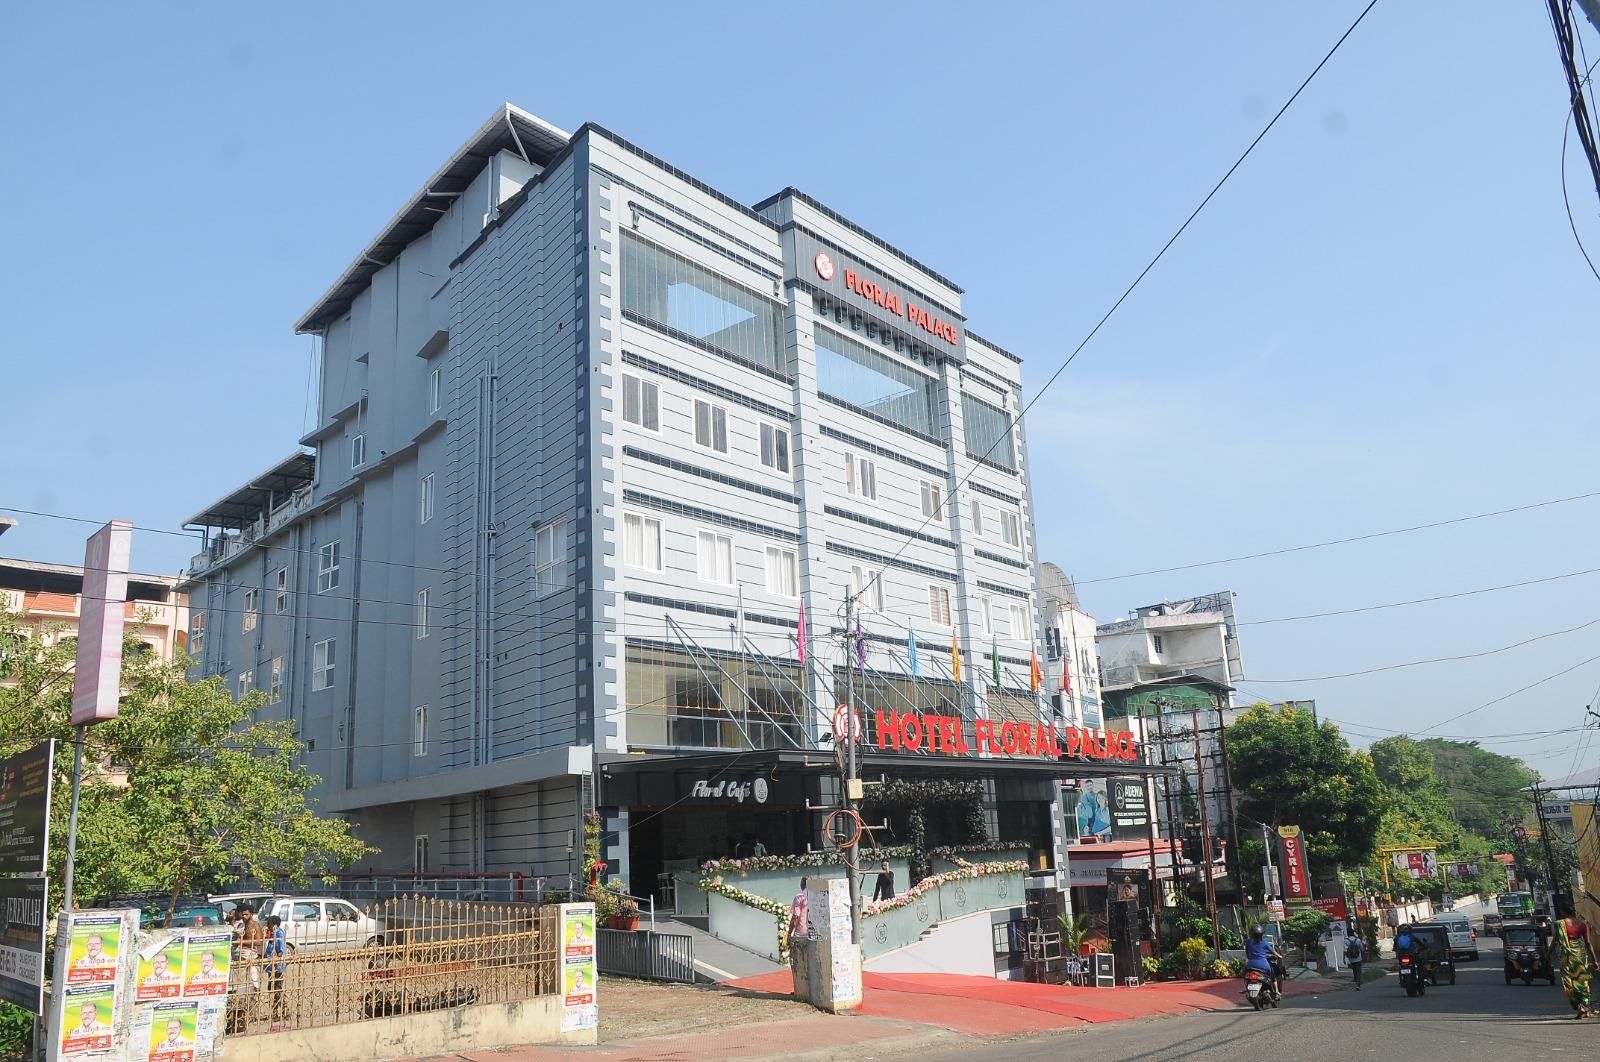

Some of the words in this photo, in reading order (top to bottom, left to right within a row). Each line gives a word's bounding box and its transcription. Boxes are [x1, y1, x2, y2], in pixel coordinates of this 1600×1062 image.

[845, 269, 904, 316] FLORAL
[907, 303, 959, 345] PALACE
[875, 707, 968, 753] HOTEL
[974, 718, 1062, 757] FLORAL
[1067, 727, 1137, 761] PALACE
[692, 780, 725, 798] Floral
[1285, 839, 1301, 893] CYRILS
[5, 897, 41, 927] JEREMIAH
